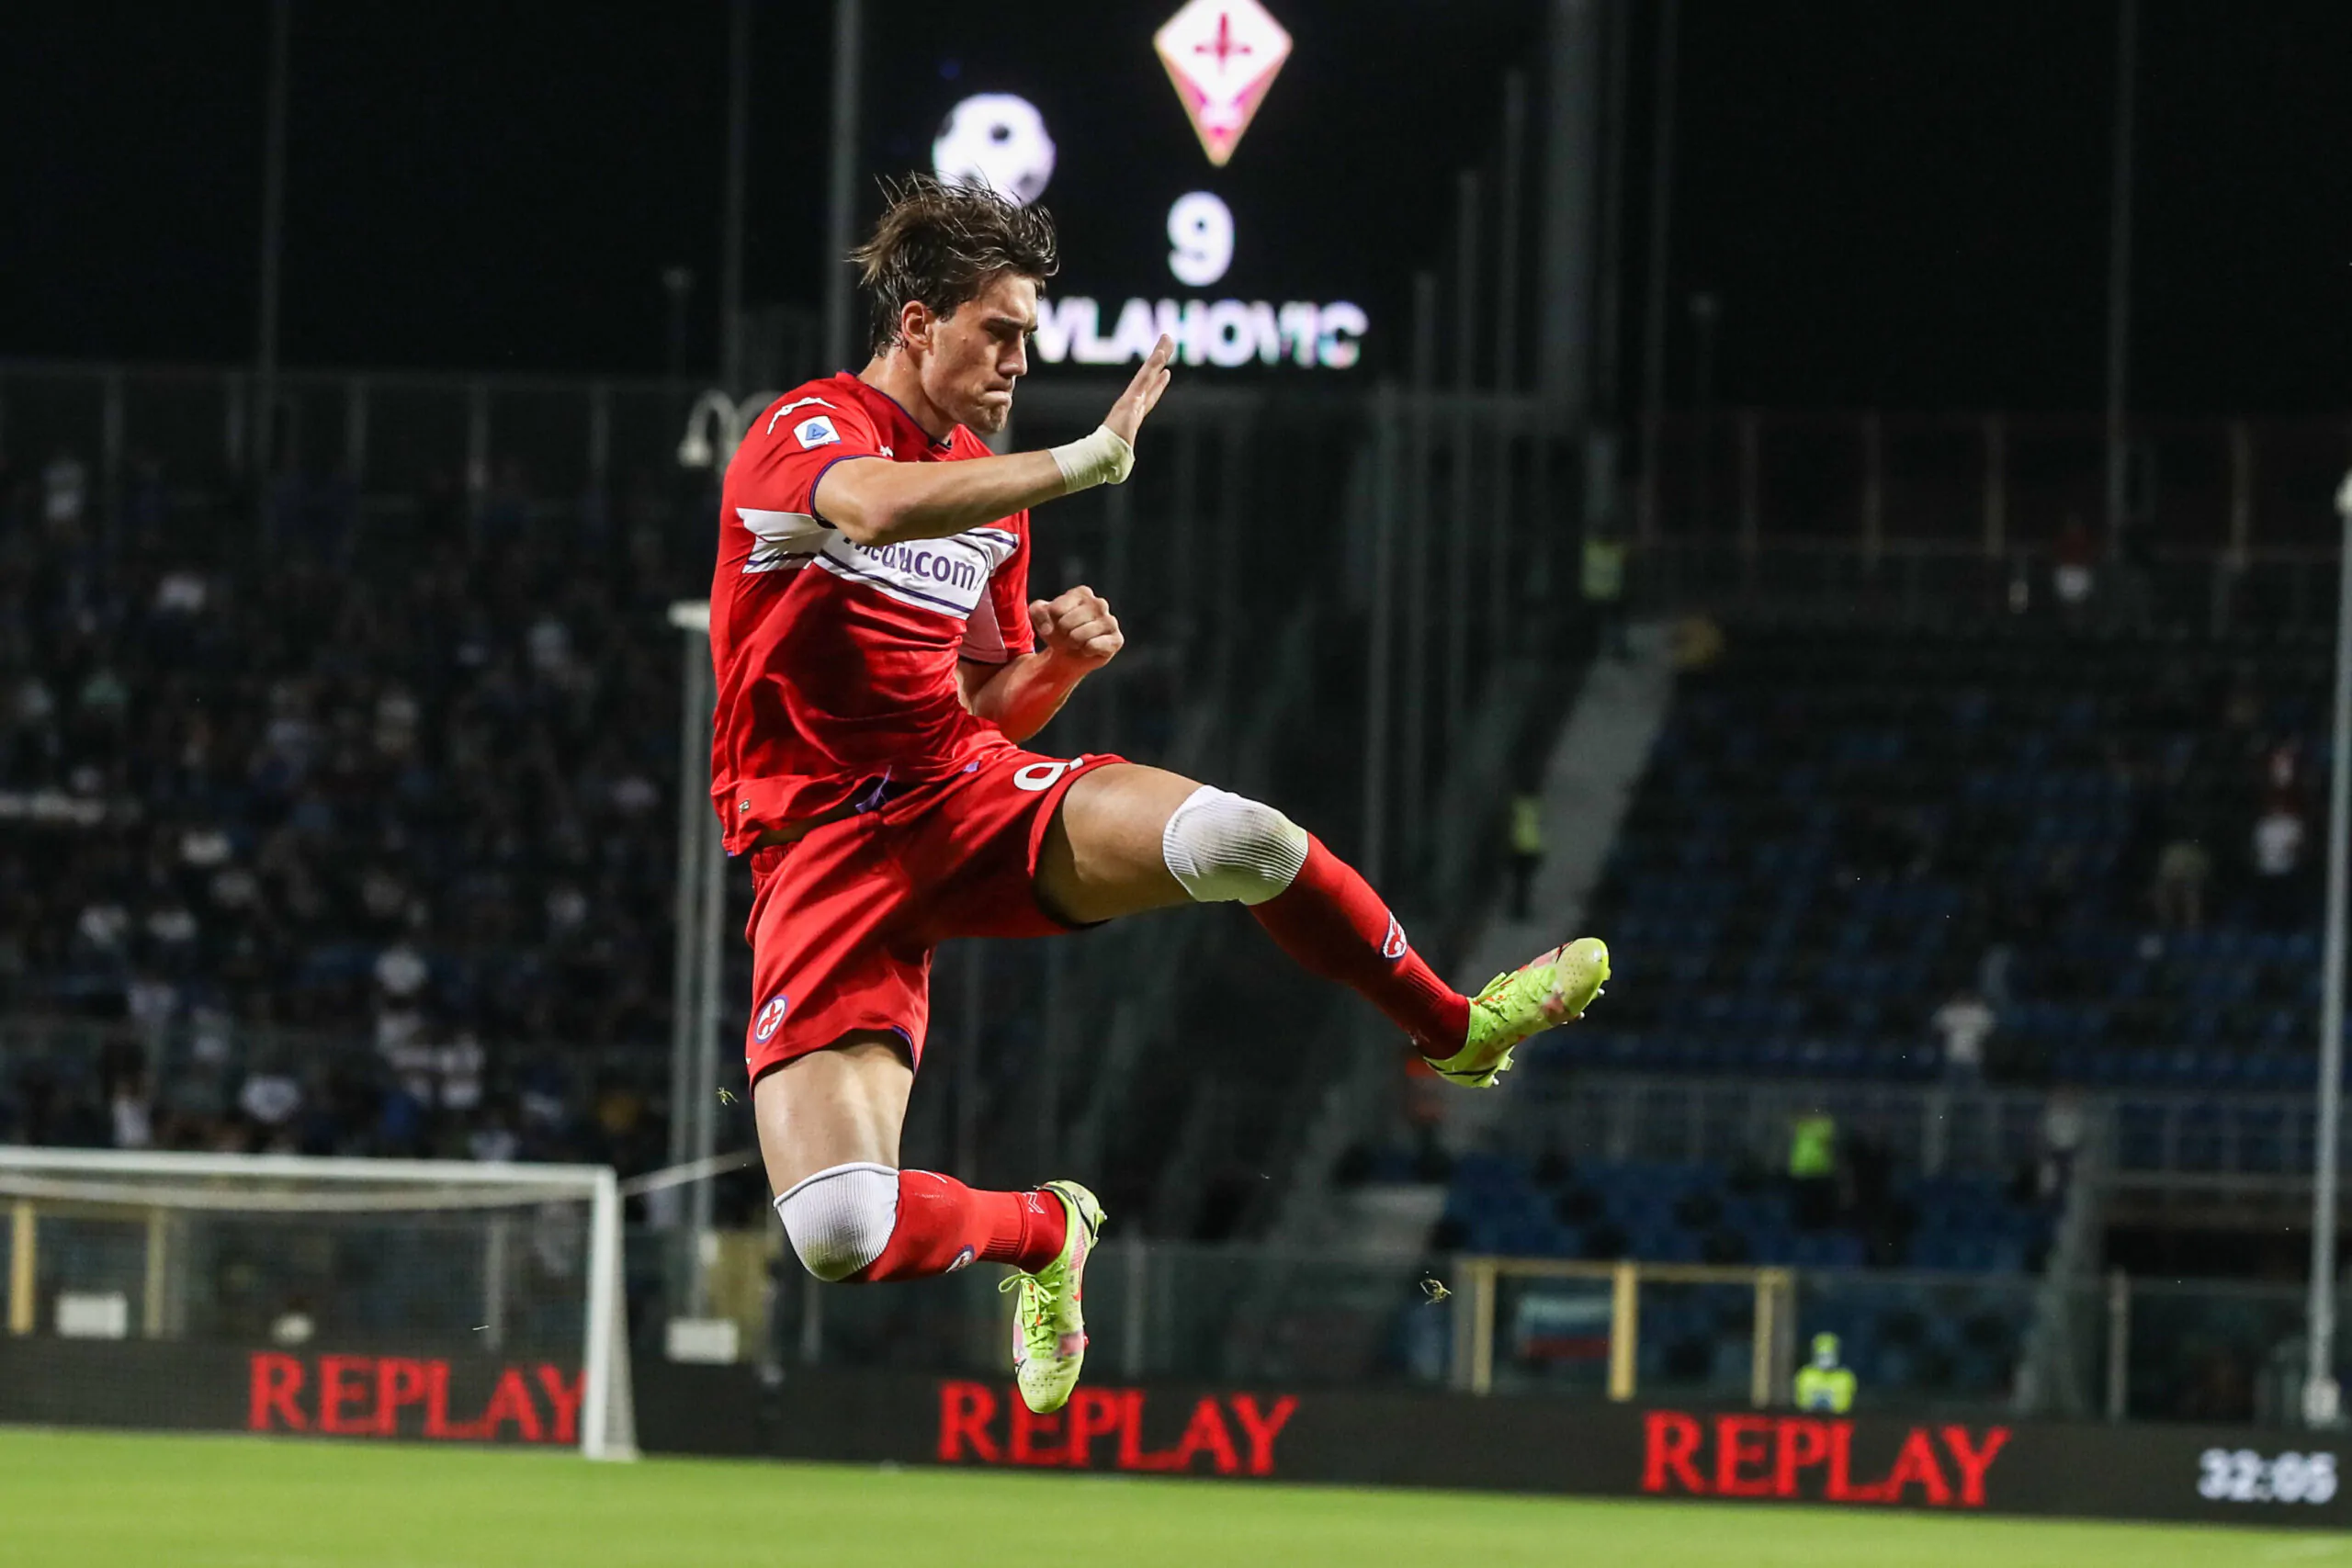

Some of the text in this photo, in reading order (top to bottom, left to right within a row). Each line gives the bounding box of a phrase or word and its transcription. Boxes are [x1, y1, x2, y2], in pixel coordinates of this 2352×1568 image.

[1167, 191, 1234, 287] 9
[1035, 296, 1369, 368] VLAHOVIC
[249, 1352, 586, 1444] REPLAY
[937, 1381, 1299, 1475] REPLAY
[1642, 1410, 2010, 1506] REPLAY
[2198, 1448, 2339, 1505] 32:05
